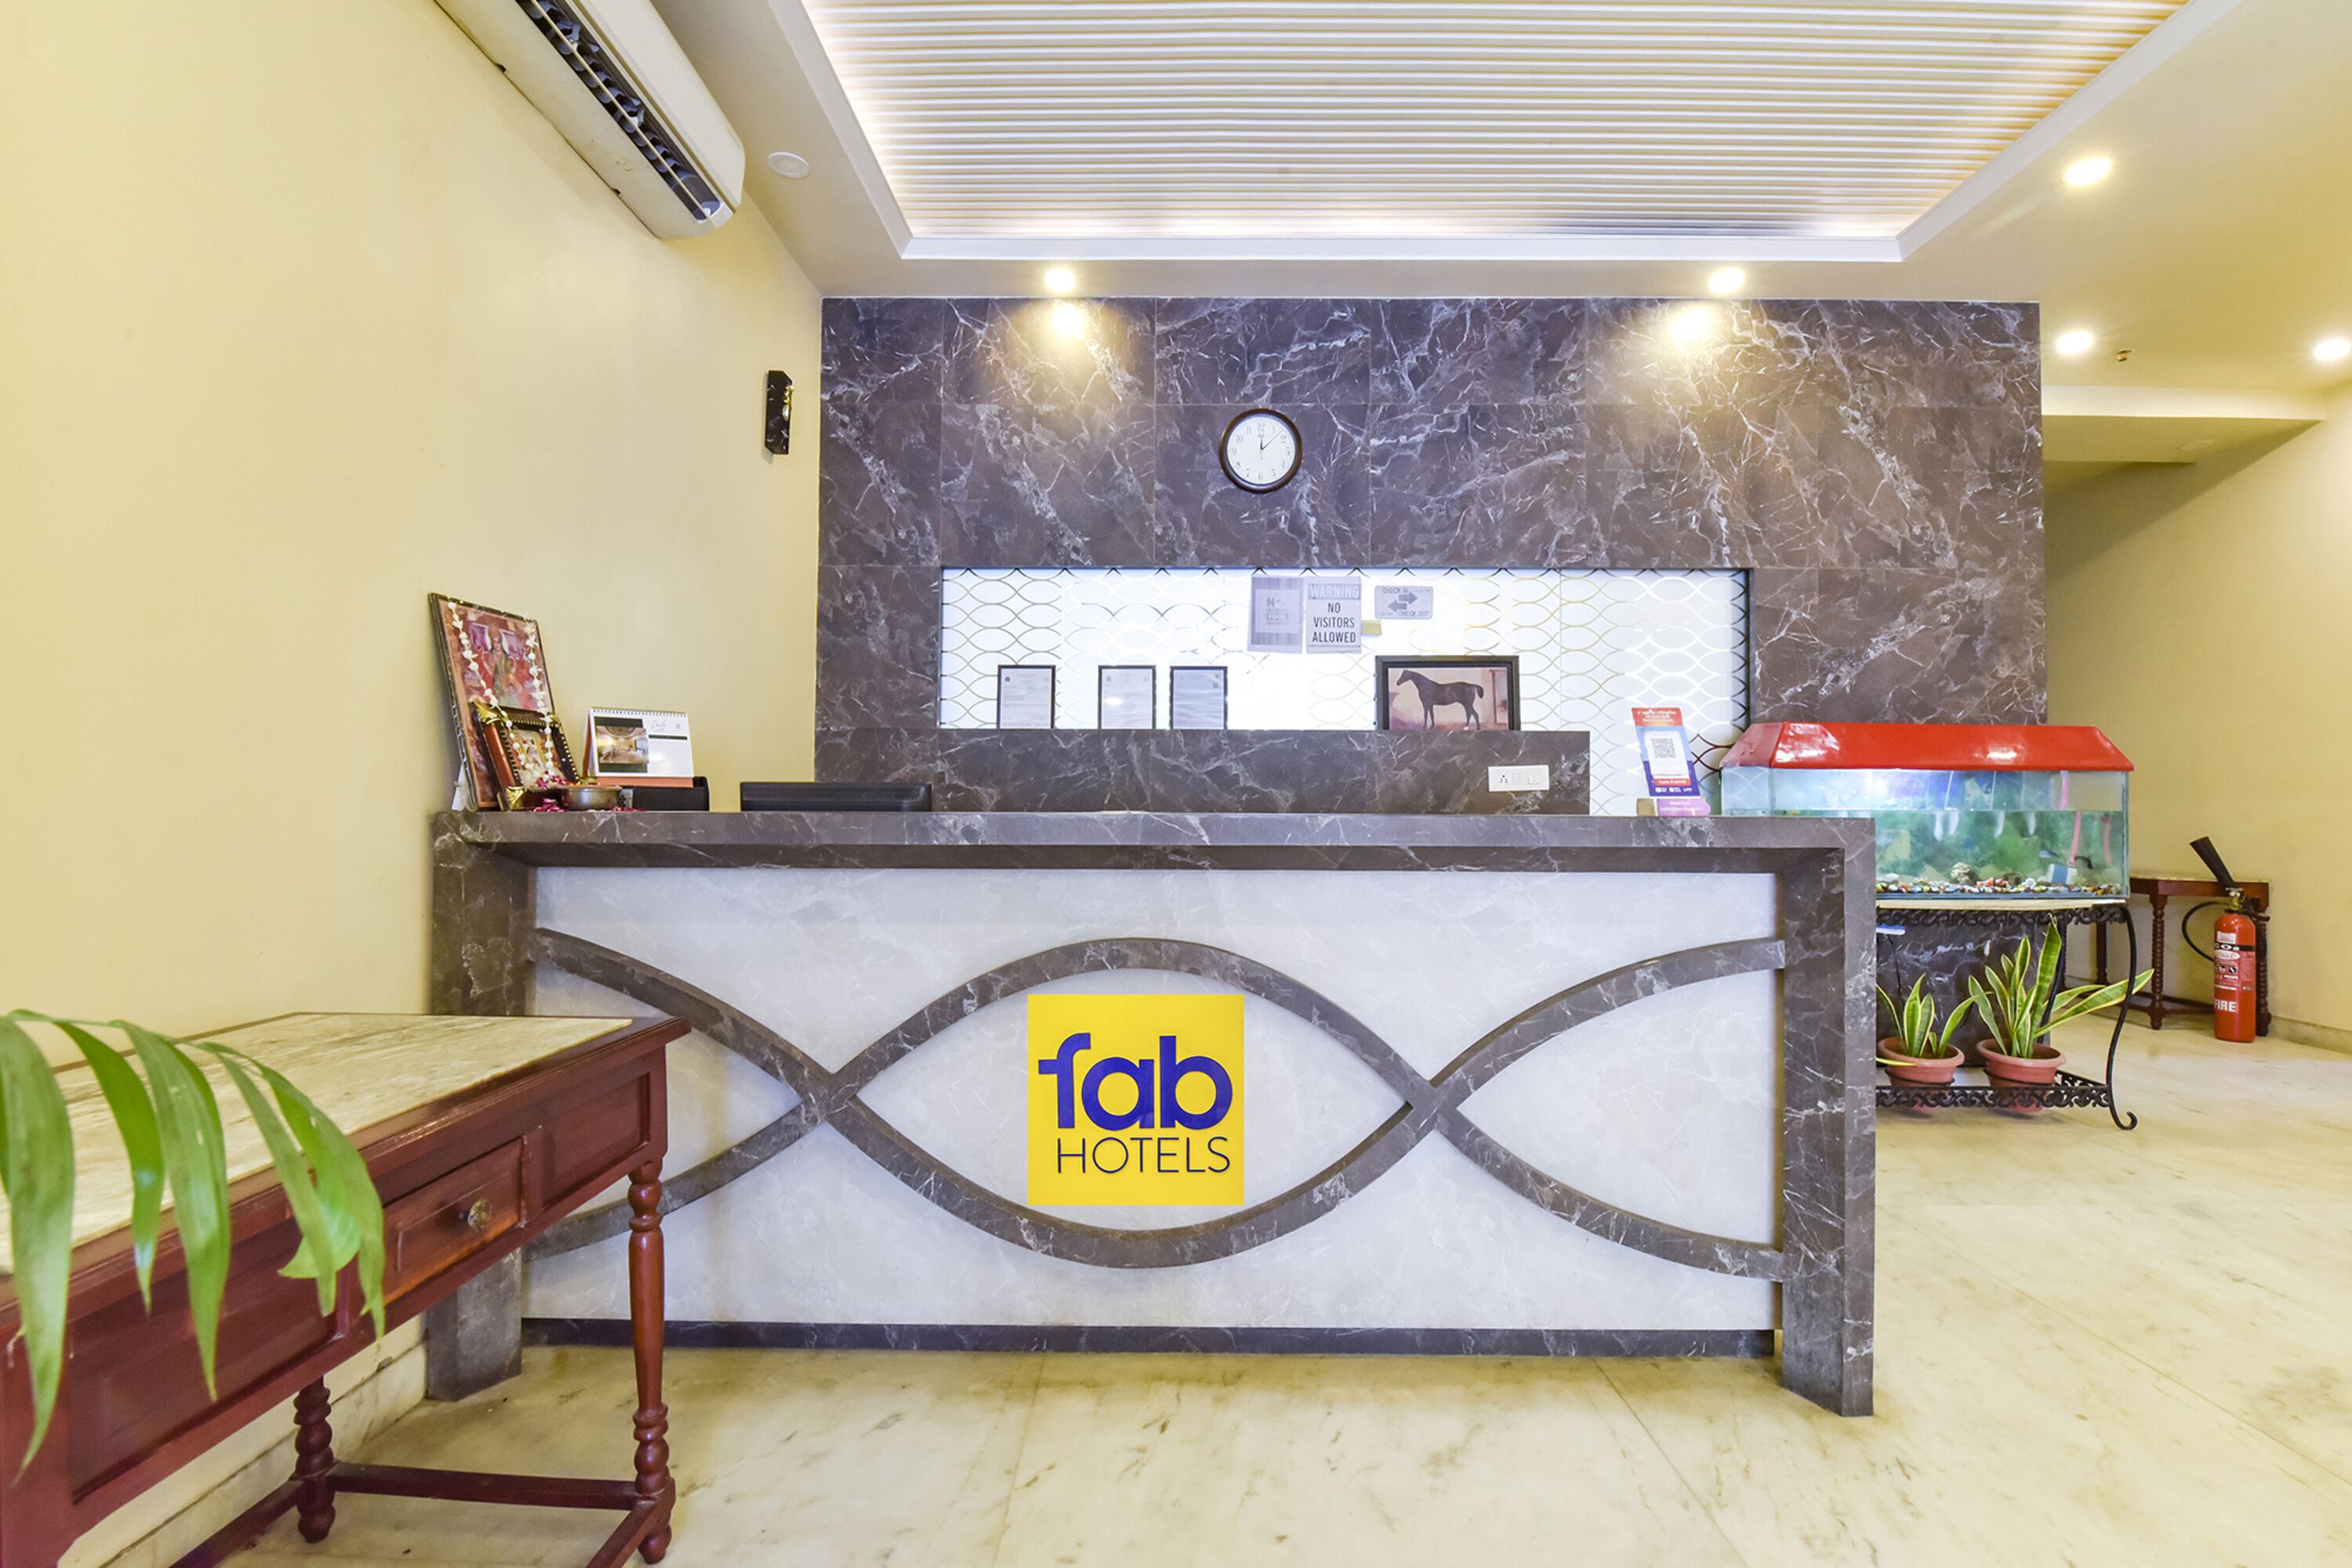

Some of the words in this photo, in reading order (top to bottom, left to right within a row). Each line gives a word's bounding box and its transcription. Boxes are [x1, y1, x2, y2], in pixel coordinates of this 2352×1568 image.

[1309, 585, 1359, 598] WARNING
[1327, 602, 1341, 613] NO
[1314, 617, 1355, 628] VISITORS
[1312, 632, 1356, 643] ALLOWED
[1038, 1032, 1233, 1131] fab
[1058, 1136, 1230, 1174] HOTELS
